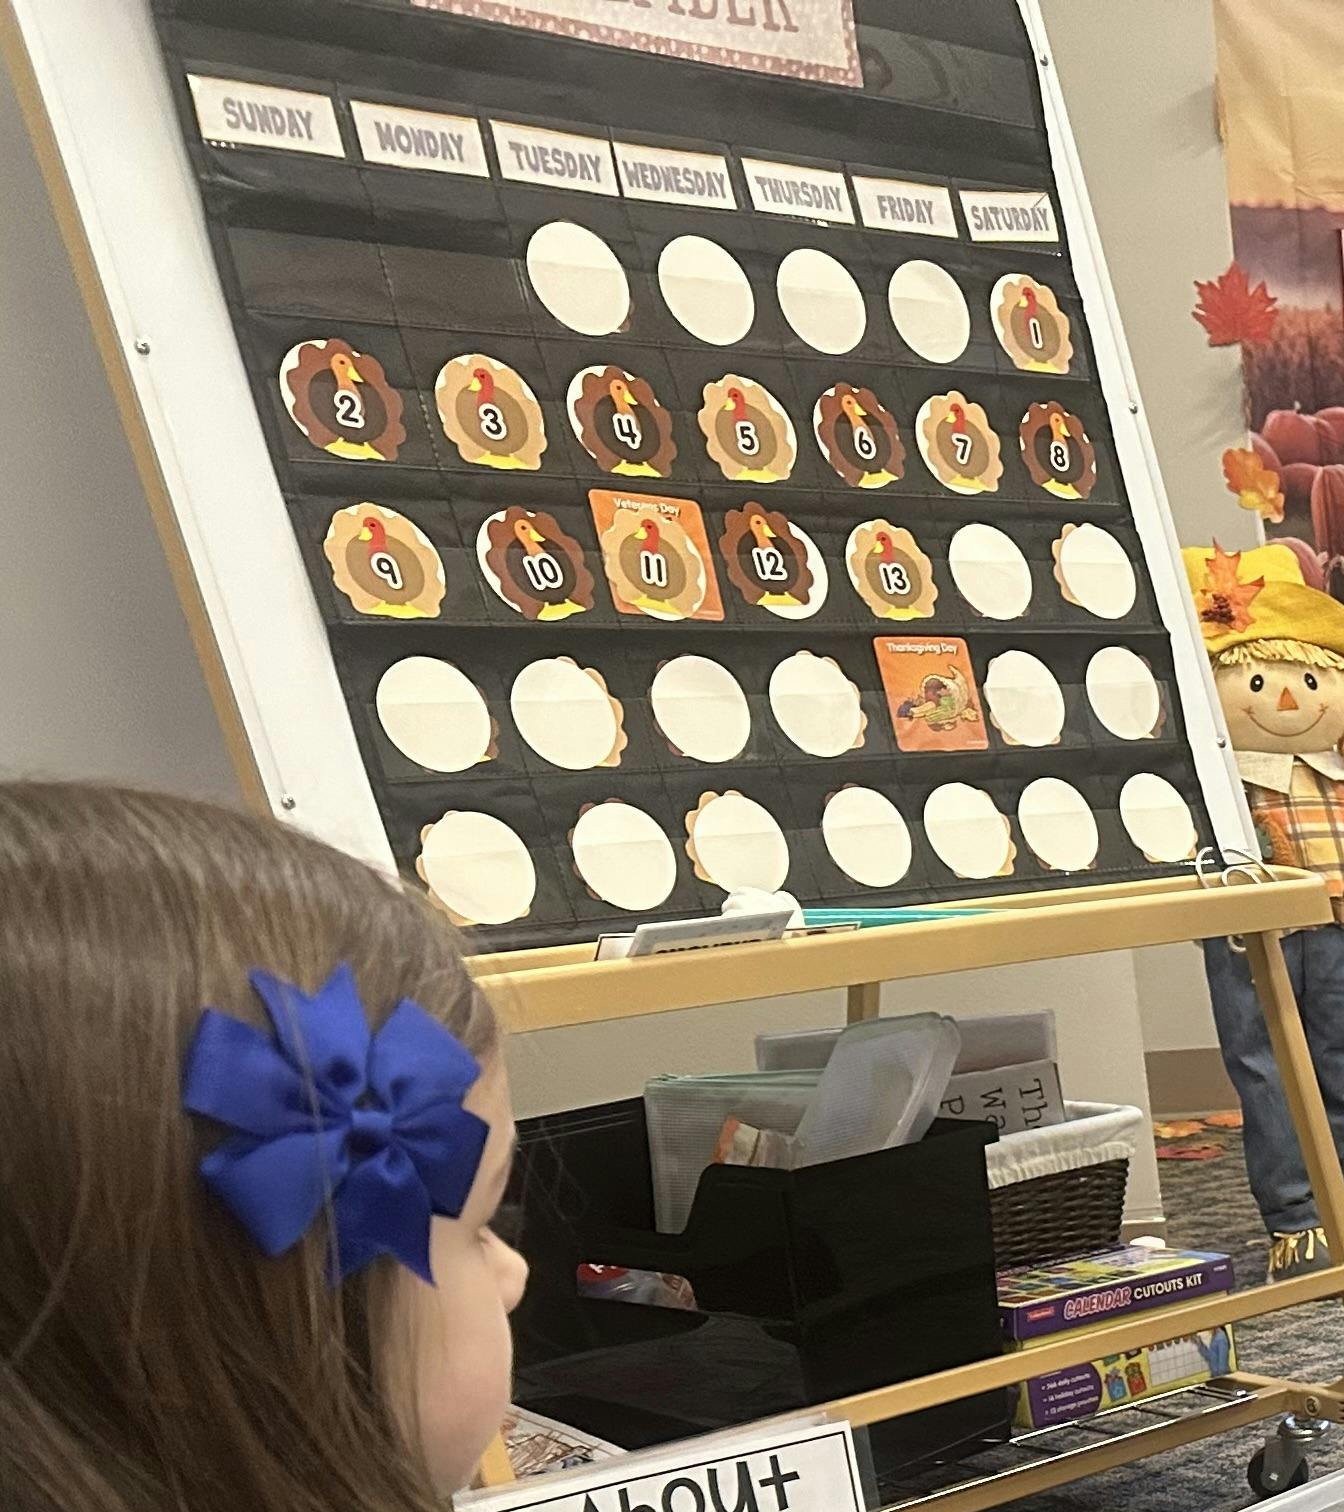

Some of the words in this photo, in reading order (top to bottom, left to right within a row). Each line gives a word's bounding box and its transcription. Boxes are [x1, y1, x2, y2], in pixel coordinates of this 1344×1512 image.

[223, 97, 313, 140] SUNDAY
[374, 121, 465, 162] MONDAY
[509, 141, 600, 182] TUESDAY
[622, 160, 726, 200] WEDNESDAY
[755, 176, 844, 211] THURSDAY
[878, 195, 934, 225] FRIDAY
[970, 205, 1049, 232] SATURDAY
[1030, 320, 1042, 347] 1
[337, 392, 361, 425] 2
[480, 405, 504, 437] 3
[614, 416, 640, 447] 4
[737, 423, 757, 453] 5
[857, 429, 875, 456] 6
[954, 435, 970, 462] 7
[1052, 444, 1067, 469] 8
[374, 554, 400, 588] 9
[525, 555, 561, 589] 10
[642, 553, 665, 585] 11
[754, 549, 785, 578] 12
[881, 565, 908, 592] 13
[887, 643, 941, 656] Thanksgiving
[941, 643, 958, 656] Day
[1019, 1078, 1048, 1128] Th
[1064, 1286, 1131, 1320] CALENDAR
[1134, 1279, 1184, 1300] CUTOUTS
[1185, 1273, 1203, 1288] KIT
